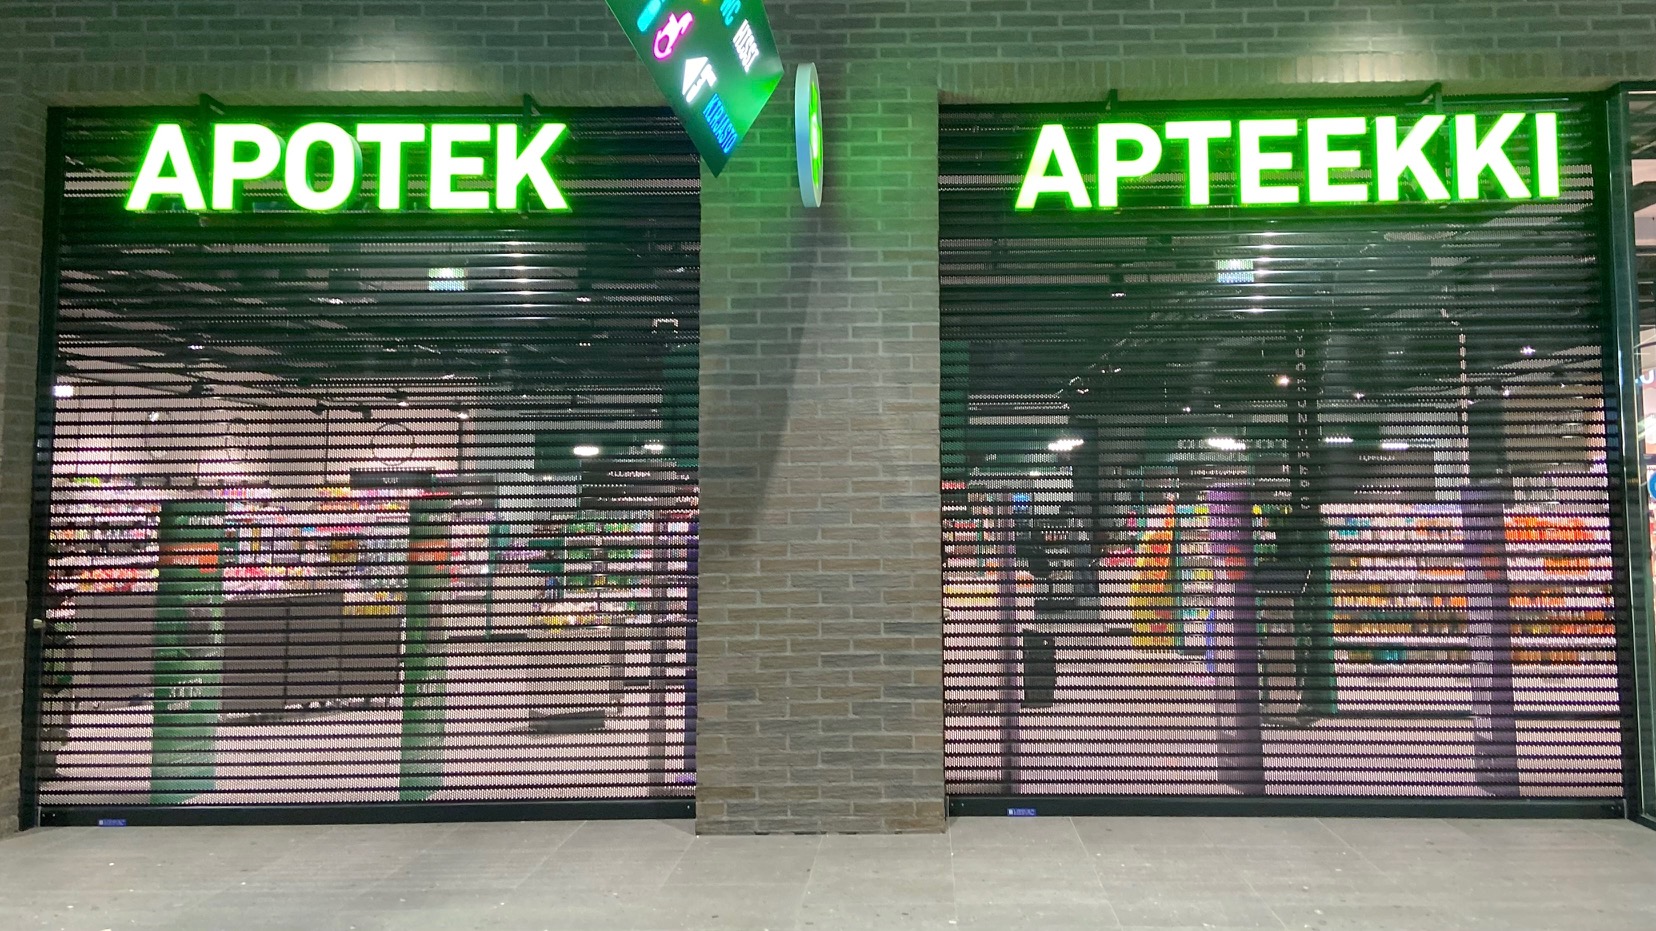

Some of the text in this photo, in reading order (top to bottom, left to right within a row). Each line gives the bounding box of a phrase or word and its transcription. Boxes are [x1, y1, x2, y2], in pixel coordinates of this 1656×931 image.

[124, 121, 571, 212] APOTEK
[702, 93, 738, 154] KIRJASTO
[1015, 112, 1561, 210] APTEEKKI
